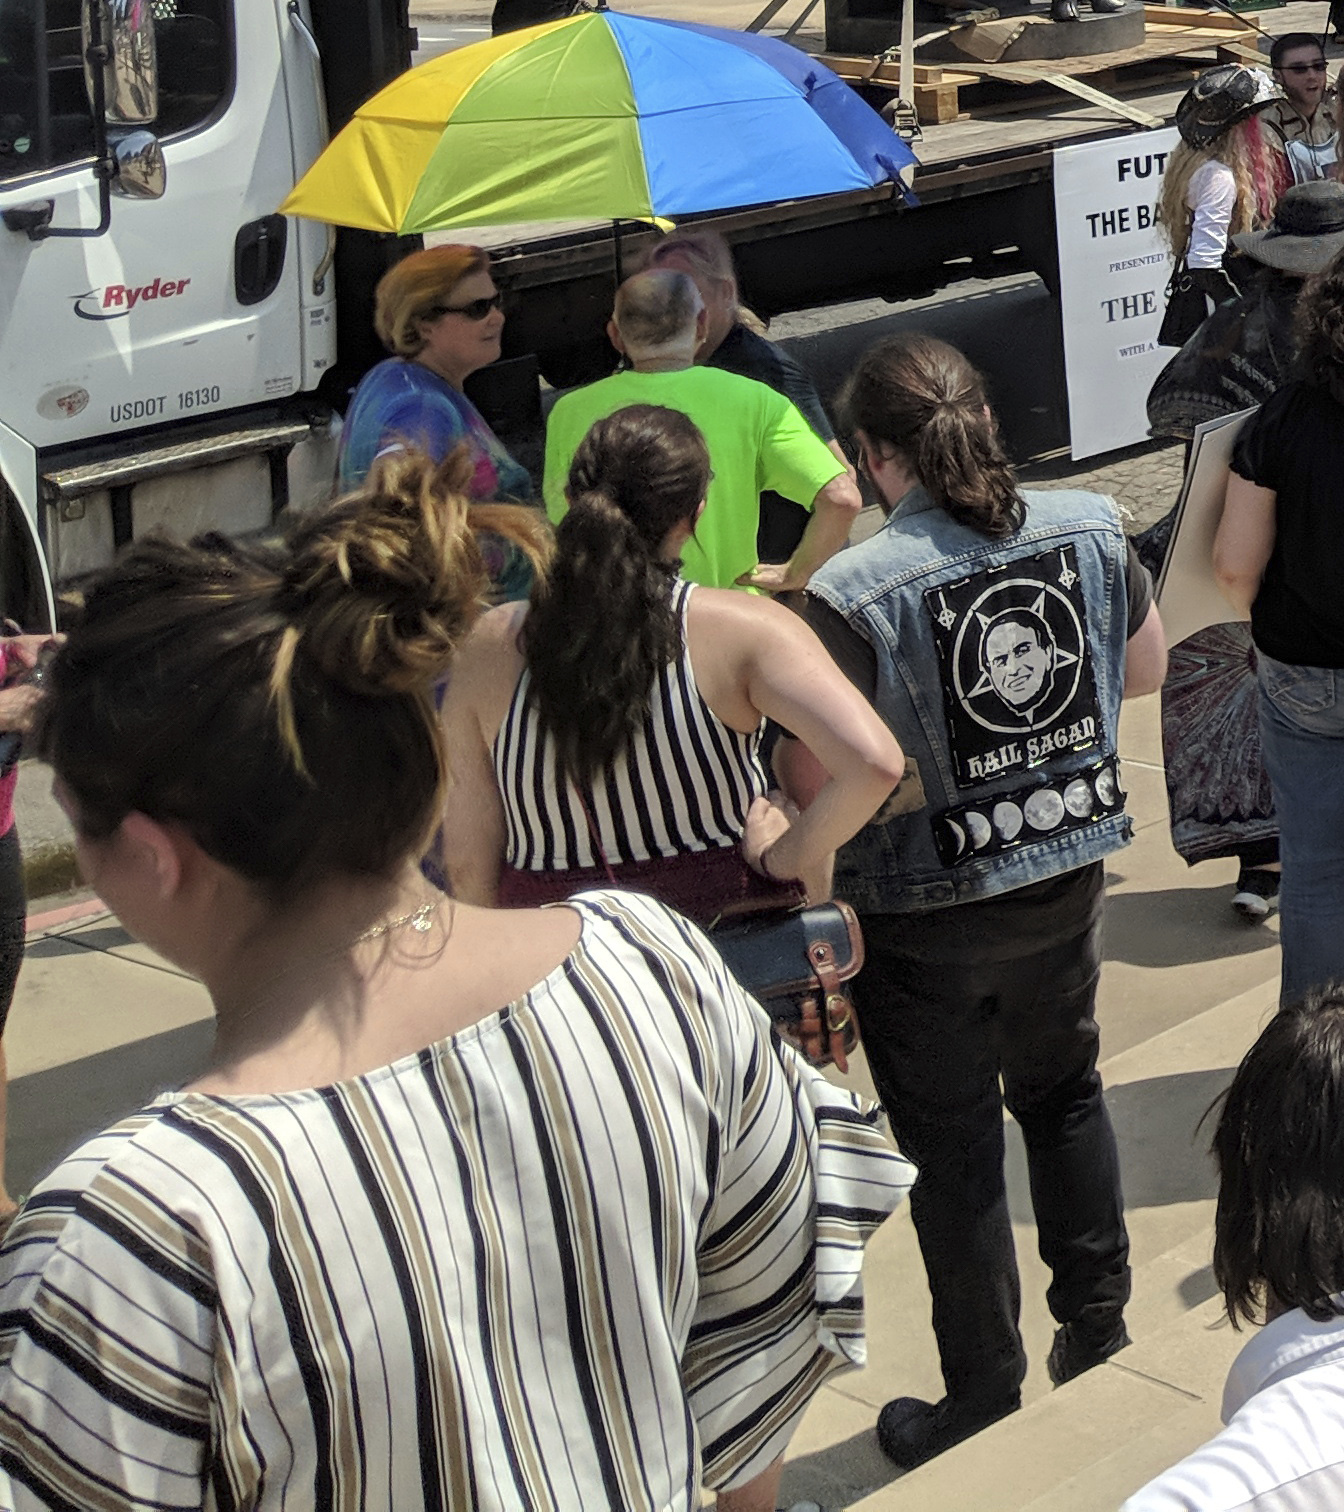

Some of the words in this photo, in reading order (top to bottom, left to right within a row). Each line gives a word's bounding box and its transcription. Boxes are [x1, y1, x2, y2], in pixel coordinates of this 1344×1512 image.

[1117, 152, 1169, 182] FUT
[1085, 207, 1131, 238] THE
[1136, 202, 1163, 230] BA
[1109, 253, 1164, 273] PRESENTED
[102, 277, 192, 310] Ryder
[1100, 290, 1158, 324] THE
[1119, 343, 1146, 358] WITH
[1147, 342, 1155, 351] A
[110, 395, 168, 423] USDOT
[177, 385, 221, 410] 16130
[1026, 715, 1096, 765] SAGAN
